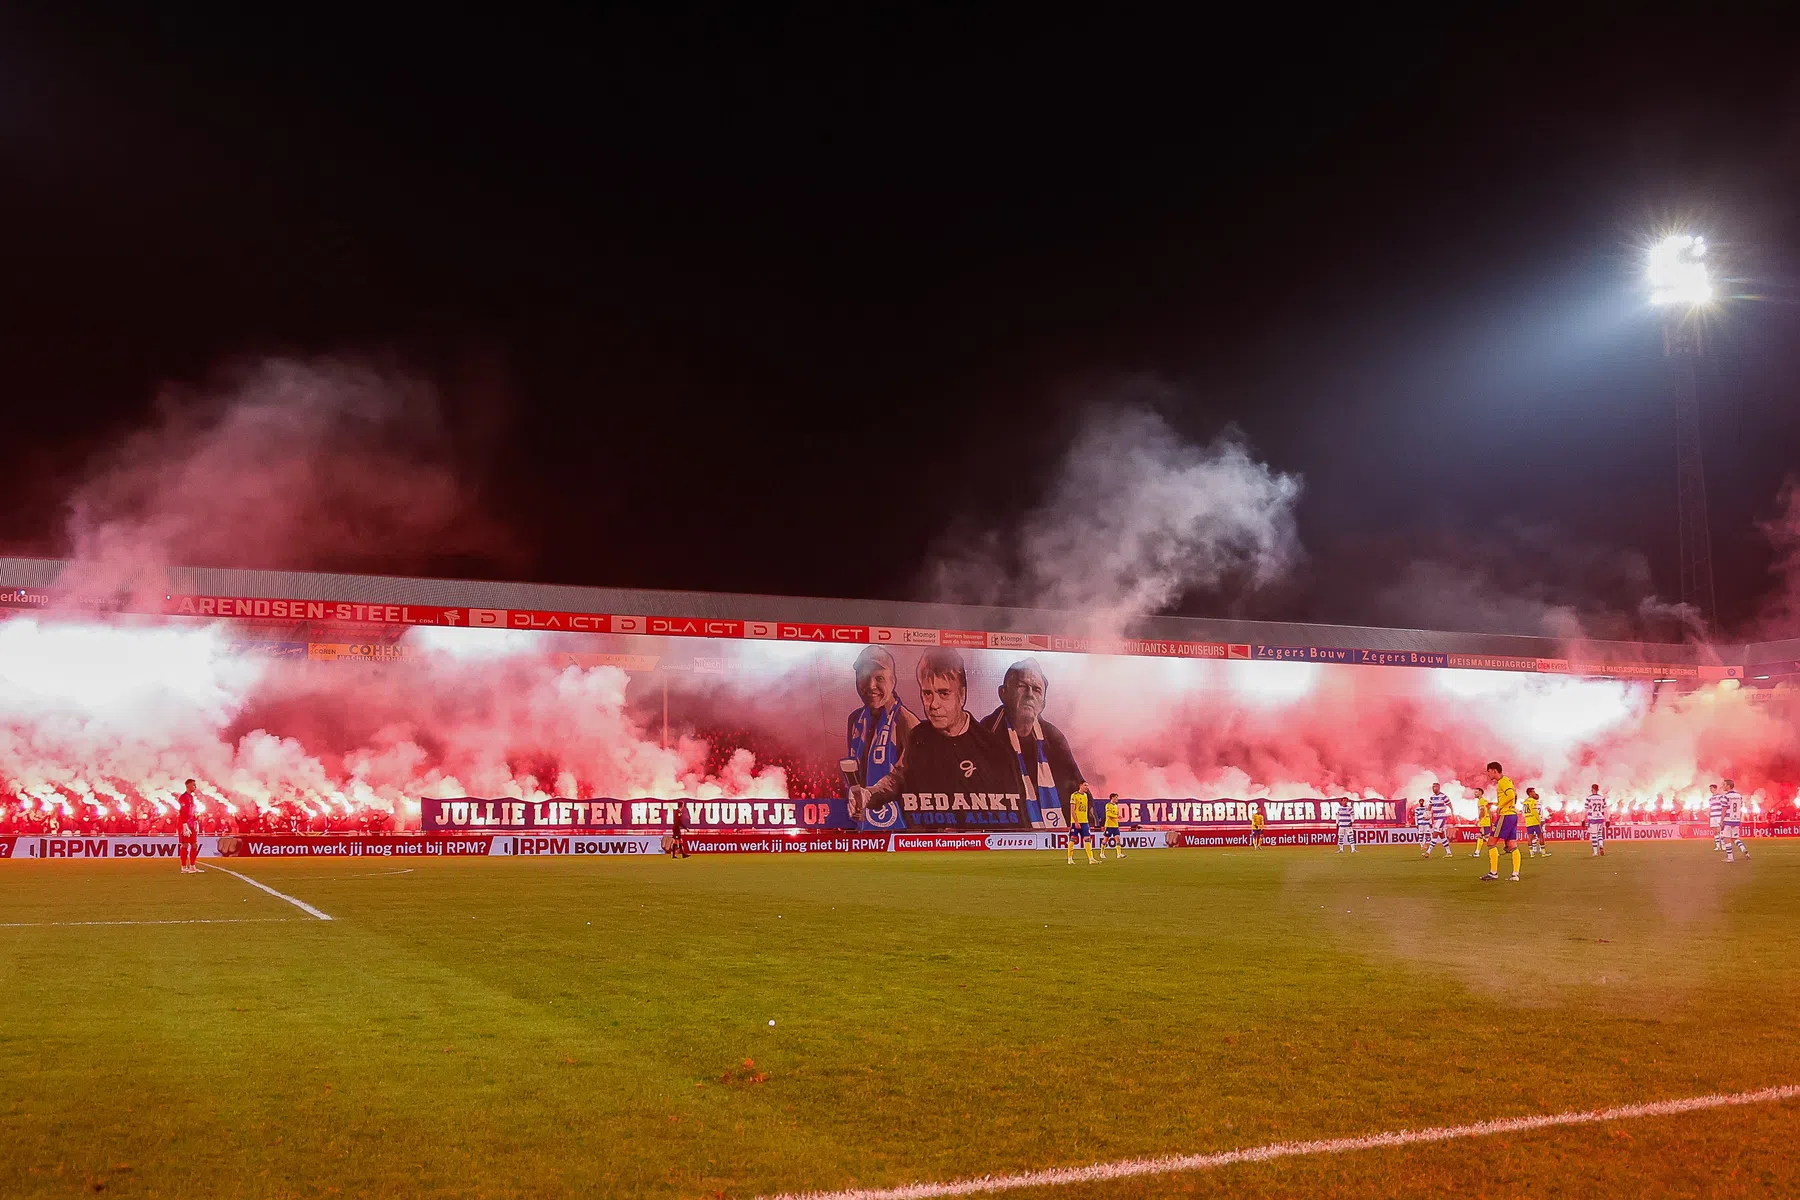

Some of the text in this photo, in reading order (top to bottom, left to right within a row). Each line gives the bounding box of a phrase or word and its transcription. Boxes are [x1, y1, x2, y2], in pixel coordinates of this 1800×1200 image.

[178, 597, 416, 623] ARENDSEN-STEEL
[514, 614, 604, 629] DLA ICT
[653, 620, 737, 634] DLA ICT
[783, 626, 863, 640] DLA ICT
[912, 631, 936, 639] Klomps
[1000, 635, 1022, 643] Klomps
[349, 644, 403, 656] COHEN
[1170, 644, 1176, 654] &
[1178, 644, 1225, 656] ADVISEURS
[1258, 645, 1345, 660] Zegers Bouw
[1362, 651, 1444, 664] Zegers Bouw
[1457, 658, 1536, 668] EISMA MEDIAGROEP
[902, 793, 1020, 811] BEDANKT
[1733, 802, 1738, 813] 8
[436, 802, 830, 826] JULLIE LIETEN HET VUURTJE OP
[911, 812, 1019, 824] VOOR ALLES
[1117, 802, 1141, 822] DE
[1264, 802, 1316, 821] WEER
[1358, 830, 1388, 843] RPM
[1557, 830, 1565, 840] bij
[1567, 830, 1588, 839] RPM?
[1606, 826, 1631, 839] RPM
[1741, 826, 1750, 836] jij
[1774, 825, 1791, 835] niet
[687, 838, 885, 853] Waarom werk jij nog niet bij RPM?
[899, 838, 981, 850] Keuken Kampioen
[997, 838, 1033, 847] divisie
[1185, 834, 1224, 845] Waarom
[1225, 834, 1248, 845] werk
[1279, 834, 1297, 844] niet
[1298, 833, 1309, 845] bij
[1311, 833, 1336, 844] RPM?
[47, 839, 105, 858] RPM
[249, 841, 486, 856] Waarom werk jij nog niet bij RPM?
[520, 838, 569, 854] RPM
